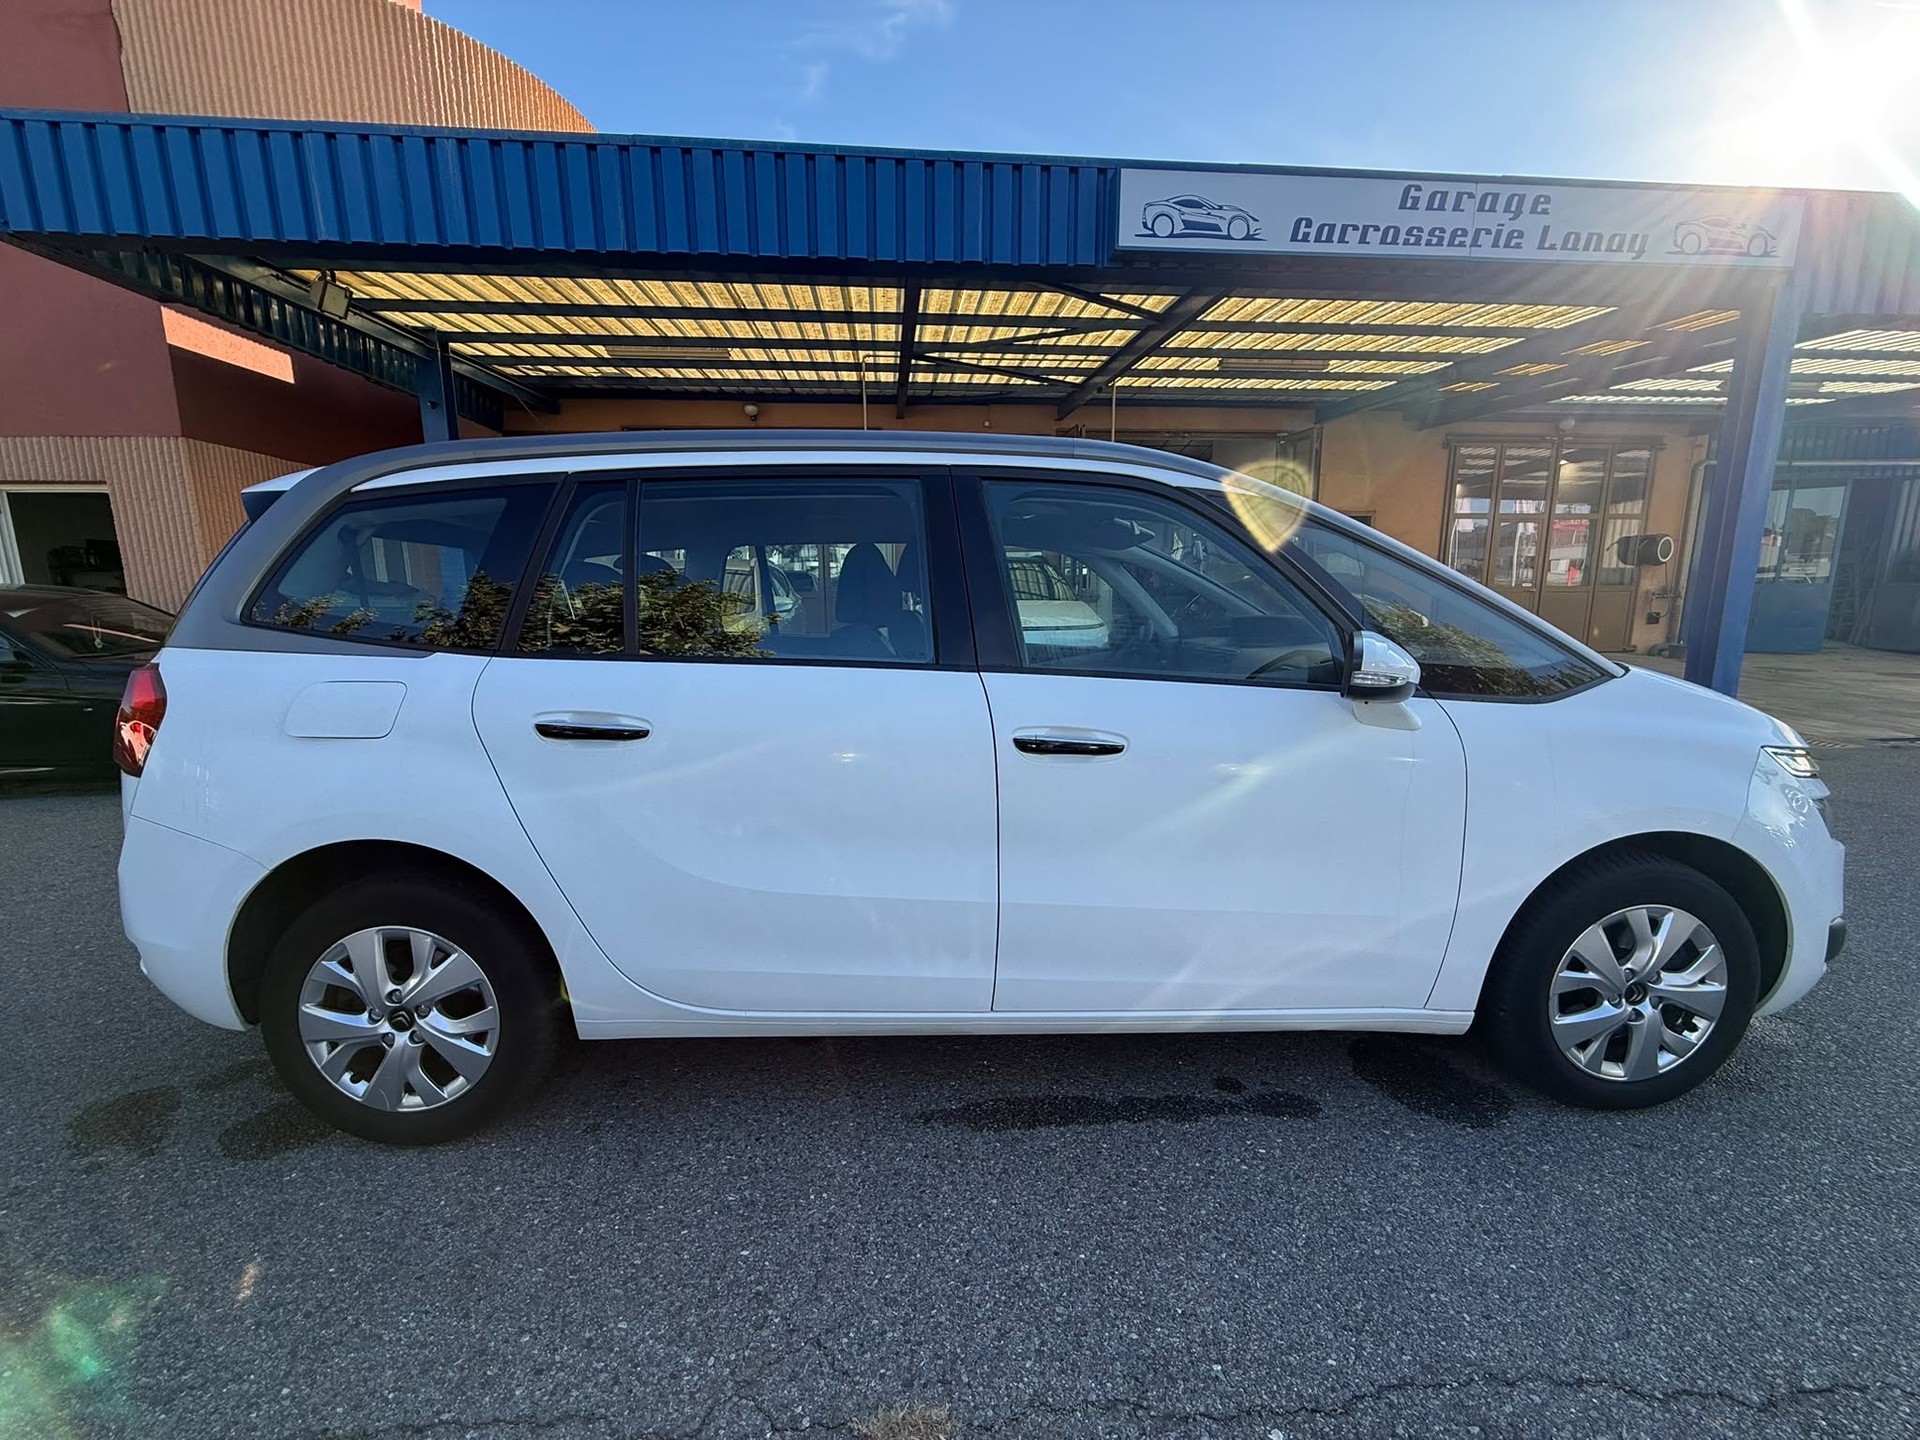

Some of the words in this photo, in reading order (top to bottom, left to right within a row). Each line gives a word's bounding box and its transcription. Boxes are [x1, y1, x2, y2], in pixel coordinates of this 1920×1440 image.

[1398, 183, 1552, 220] Garage
[1289, 216, 1525, 250] Carrosserie
[1536, 224, 1650, 260] Lonay
